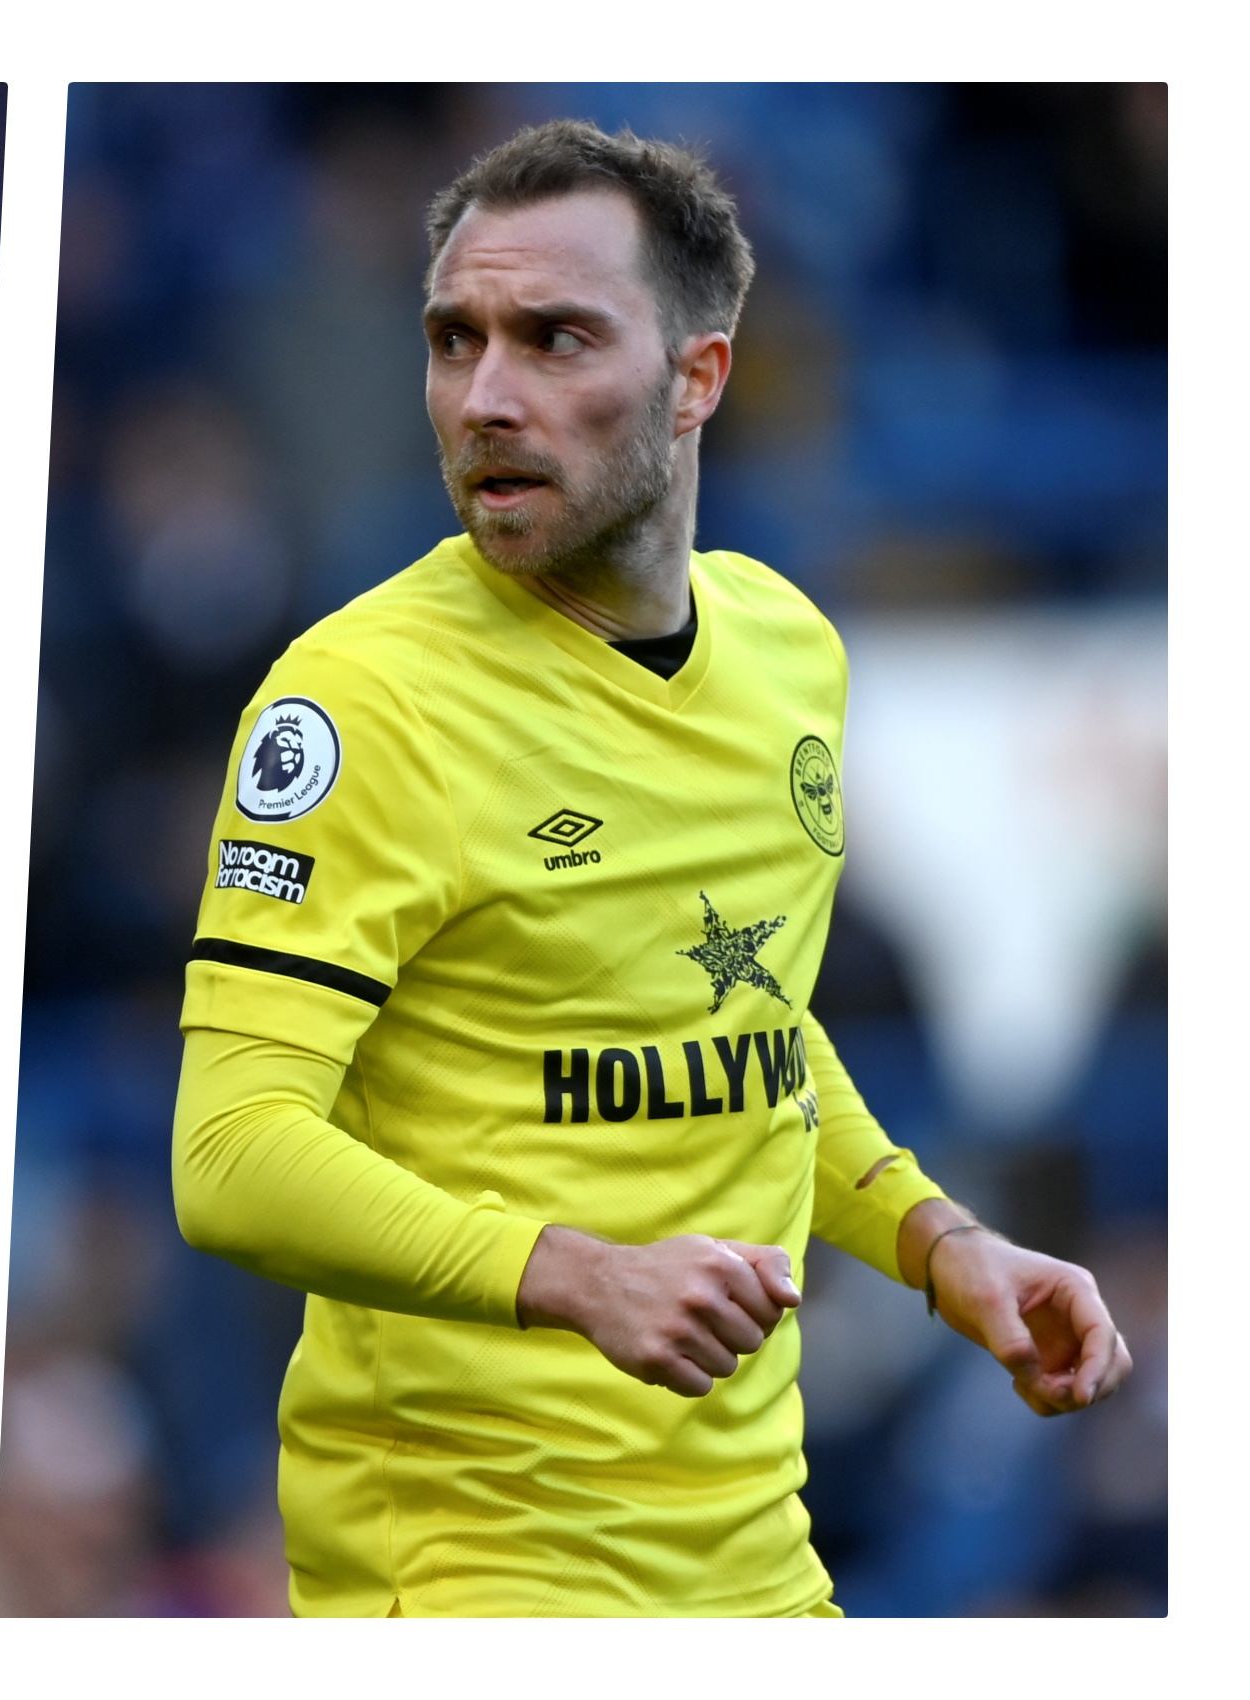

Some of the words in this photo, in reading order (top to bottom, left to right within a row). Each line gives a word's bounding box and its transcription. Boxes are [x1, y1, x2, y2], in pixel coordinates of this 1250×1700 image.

[258, 797, 294, 810] Premier
[294, 764, 321, 800] League
[219, 840, 239, 866] No
[236, 846, 300, 879] room
[543, 849, 601, 871] umbro
[230, 868, 305, 904] racism
